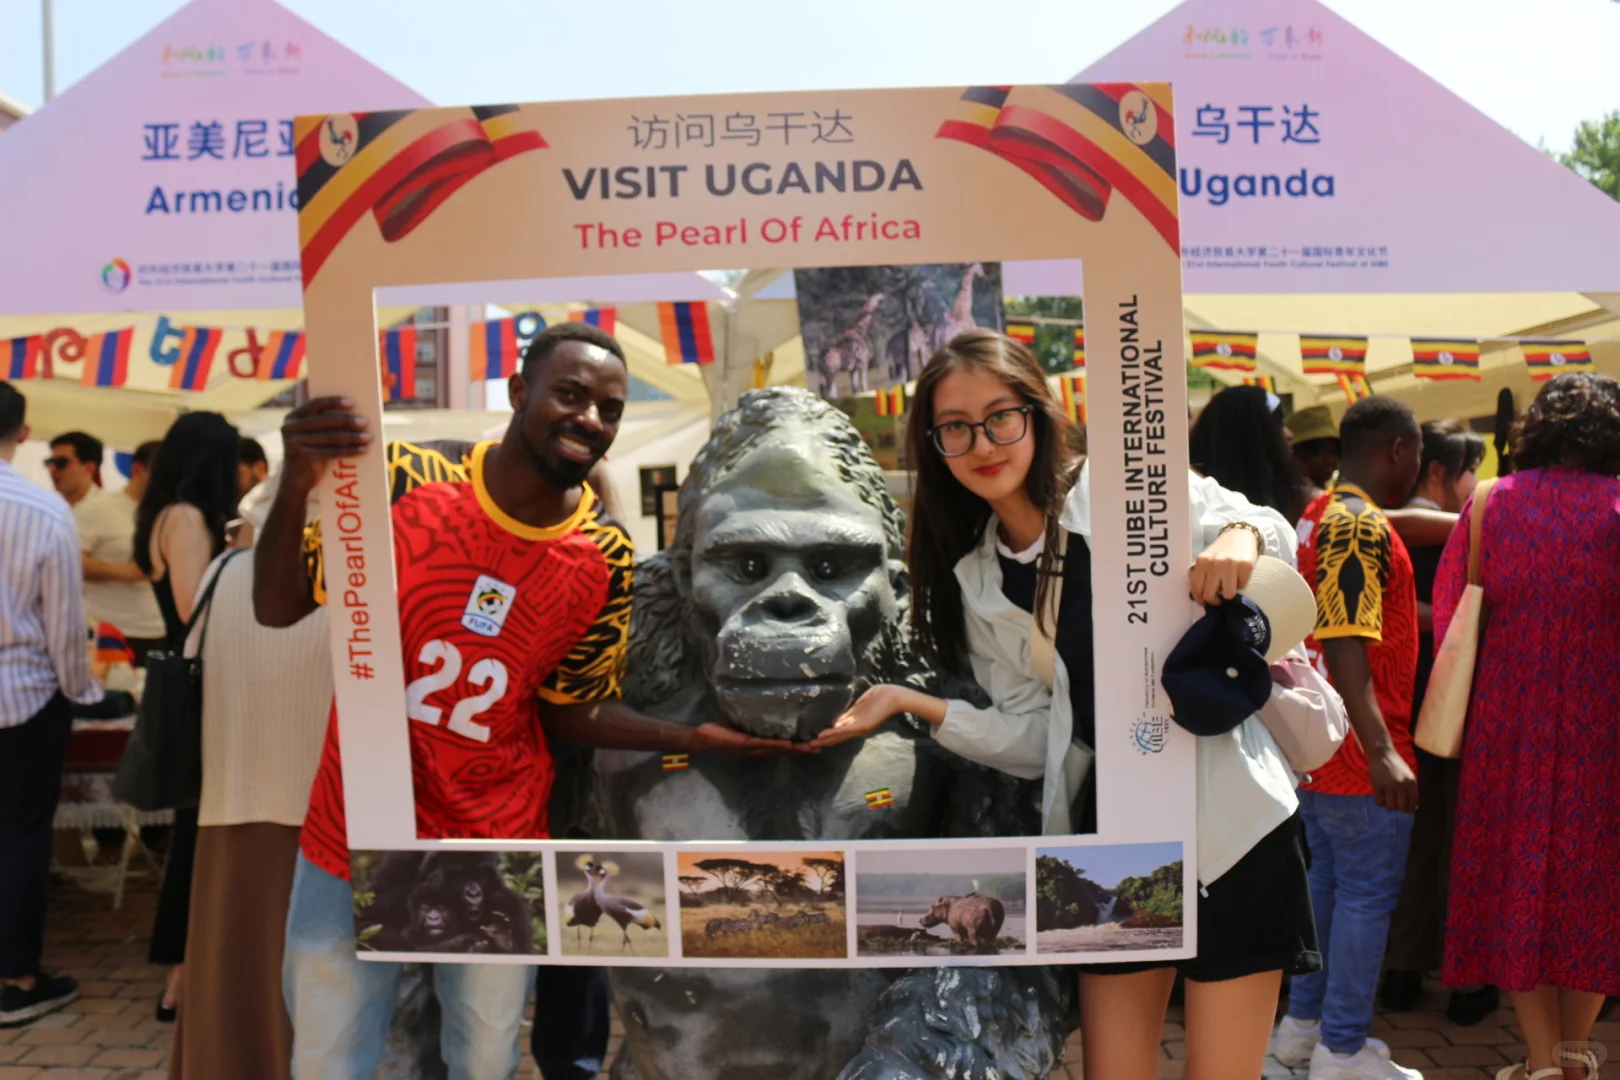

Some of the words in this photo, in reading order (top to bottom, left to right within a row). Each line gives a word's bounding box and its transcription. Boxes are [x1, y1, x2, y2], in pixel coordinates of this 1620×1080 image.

[627, 109, 855, 149] 访问乌干达
[1191, 103, 1321, 144] 乌干达
[561, 165, 688, 201] VISIT
[705, 158, 924, 196] UGANDA
[1179, 167, 1335, 206] Uganda
[574, 222, 643, 250] The
[655, 217, 748, 247] Pearl
[760, 214, 803, 244] Of
[813, 212, 922, 243] Africa
[1118, 294, 1144, 491] INTERNATIONAL
[1143, 340, 1165, 455] FESTIVAL
[1125, 500, 1146, 557] UIBE
[1147, 464, 1169, 576] CULTURE
[332, 459, 375, 680] #ThePearlOfAfr
[1126, 564, 1148, 624] 21ST
[405, 638, 509, 744] 22
